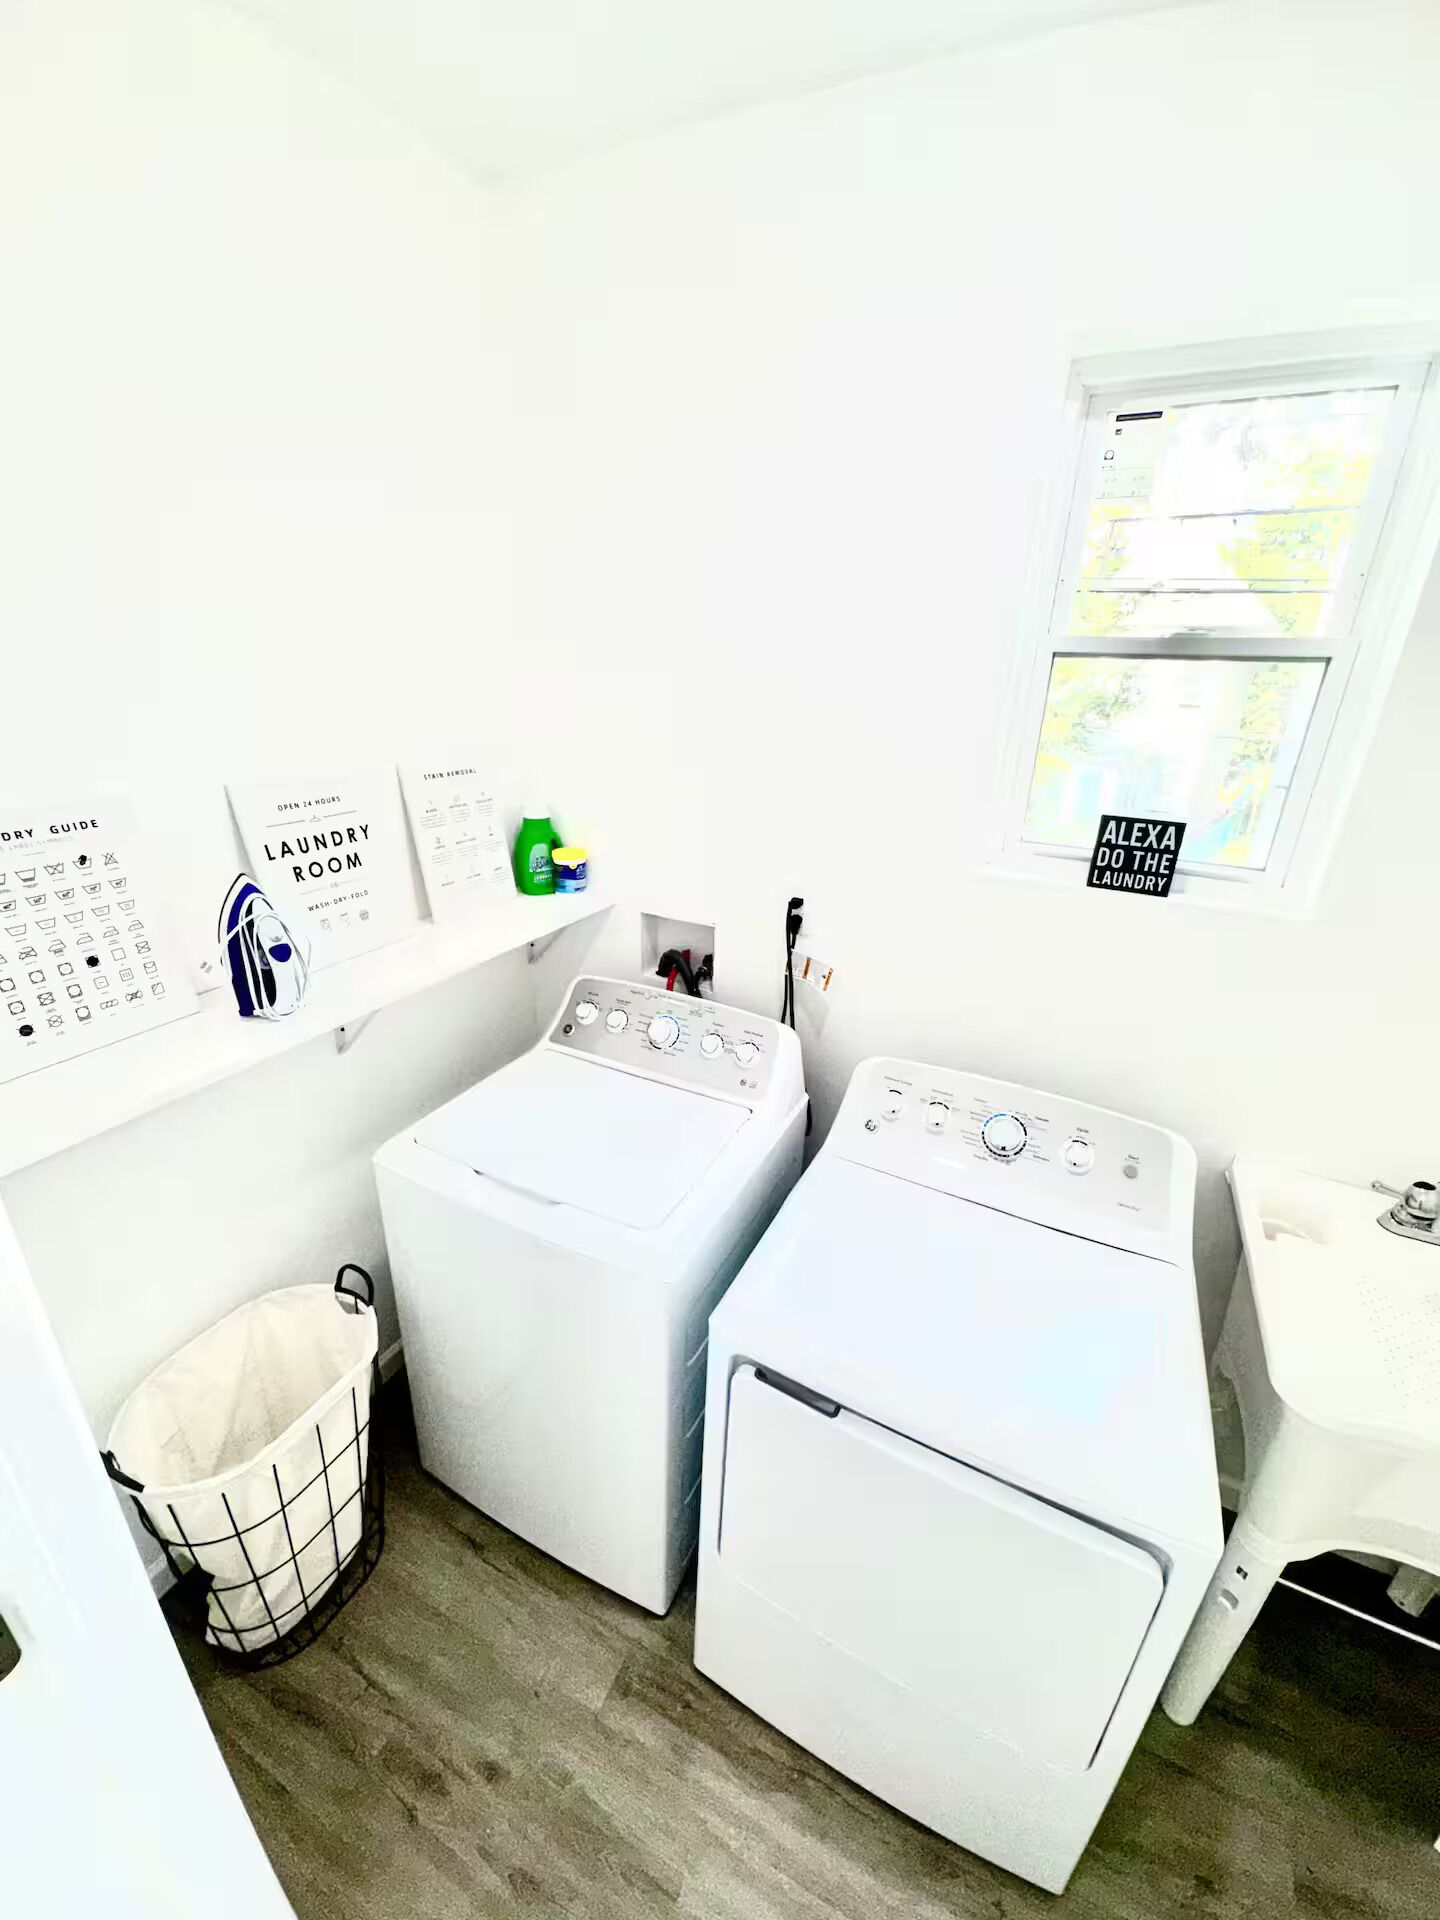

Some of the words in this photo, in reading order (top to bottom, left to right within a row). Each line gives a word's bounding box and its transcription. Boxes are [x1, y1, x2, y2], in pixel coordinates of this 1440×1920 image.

[423, 772, 444, 781] STAIN
[446, 768, 477, 778] REMOVAL
[277, 803, 300, 812] OPEN
[303, 800, 313, 808] 24
[315, 796, 341, 806] HOURS
[49, 819, 99, 834] GUIDE
[1101, 820, 1176, 851] ALEXA
[264, 824, 369, 861] LAUNDRY
[292, 852, 363, 882] ROOM
[1096, 847, 1125, 868] DO
[1133, 851, 1174, 874] THE
[1093, 869, 1167, 892] LAUNDRY
